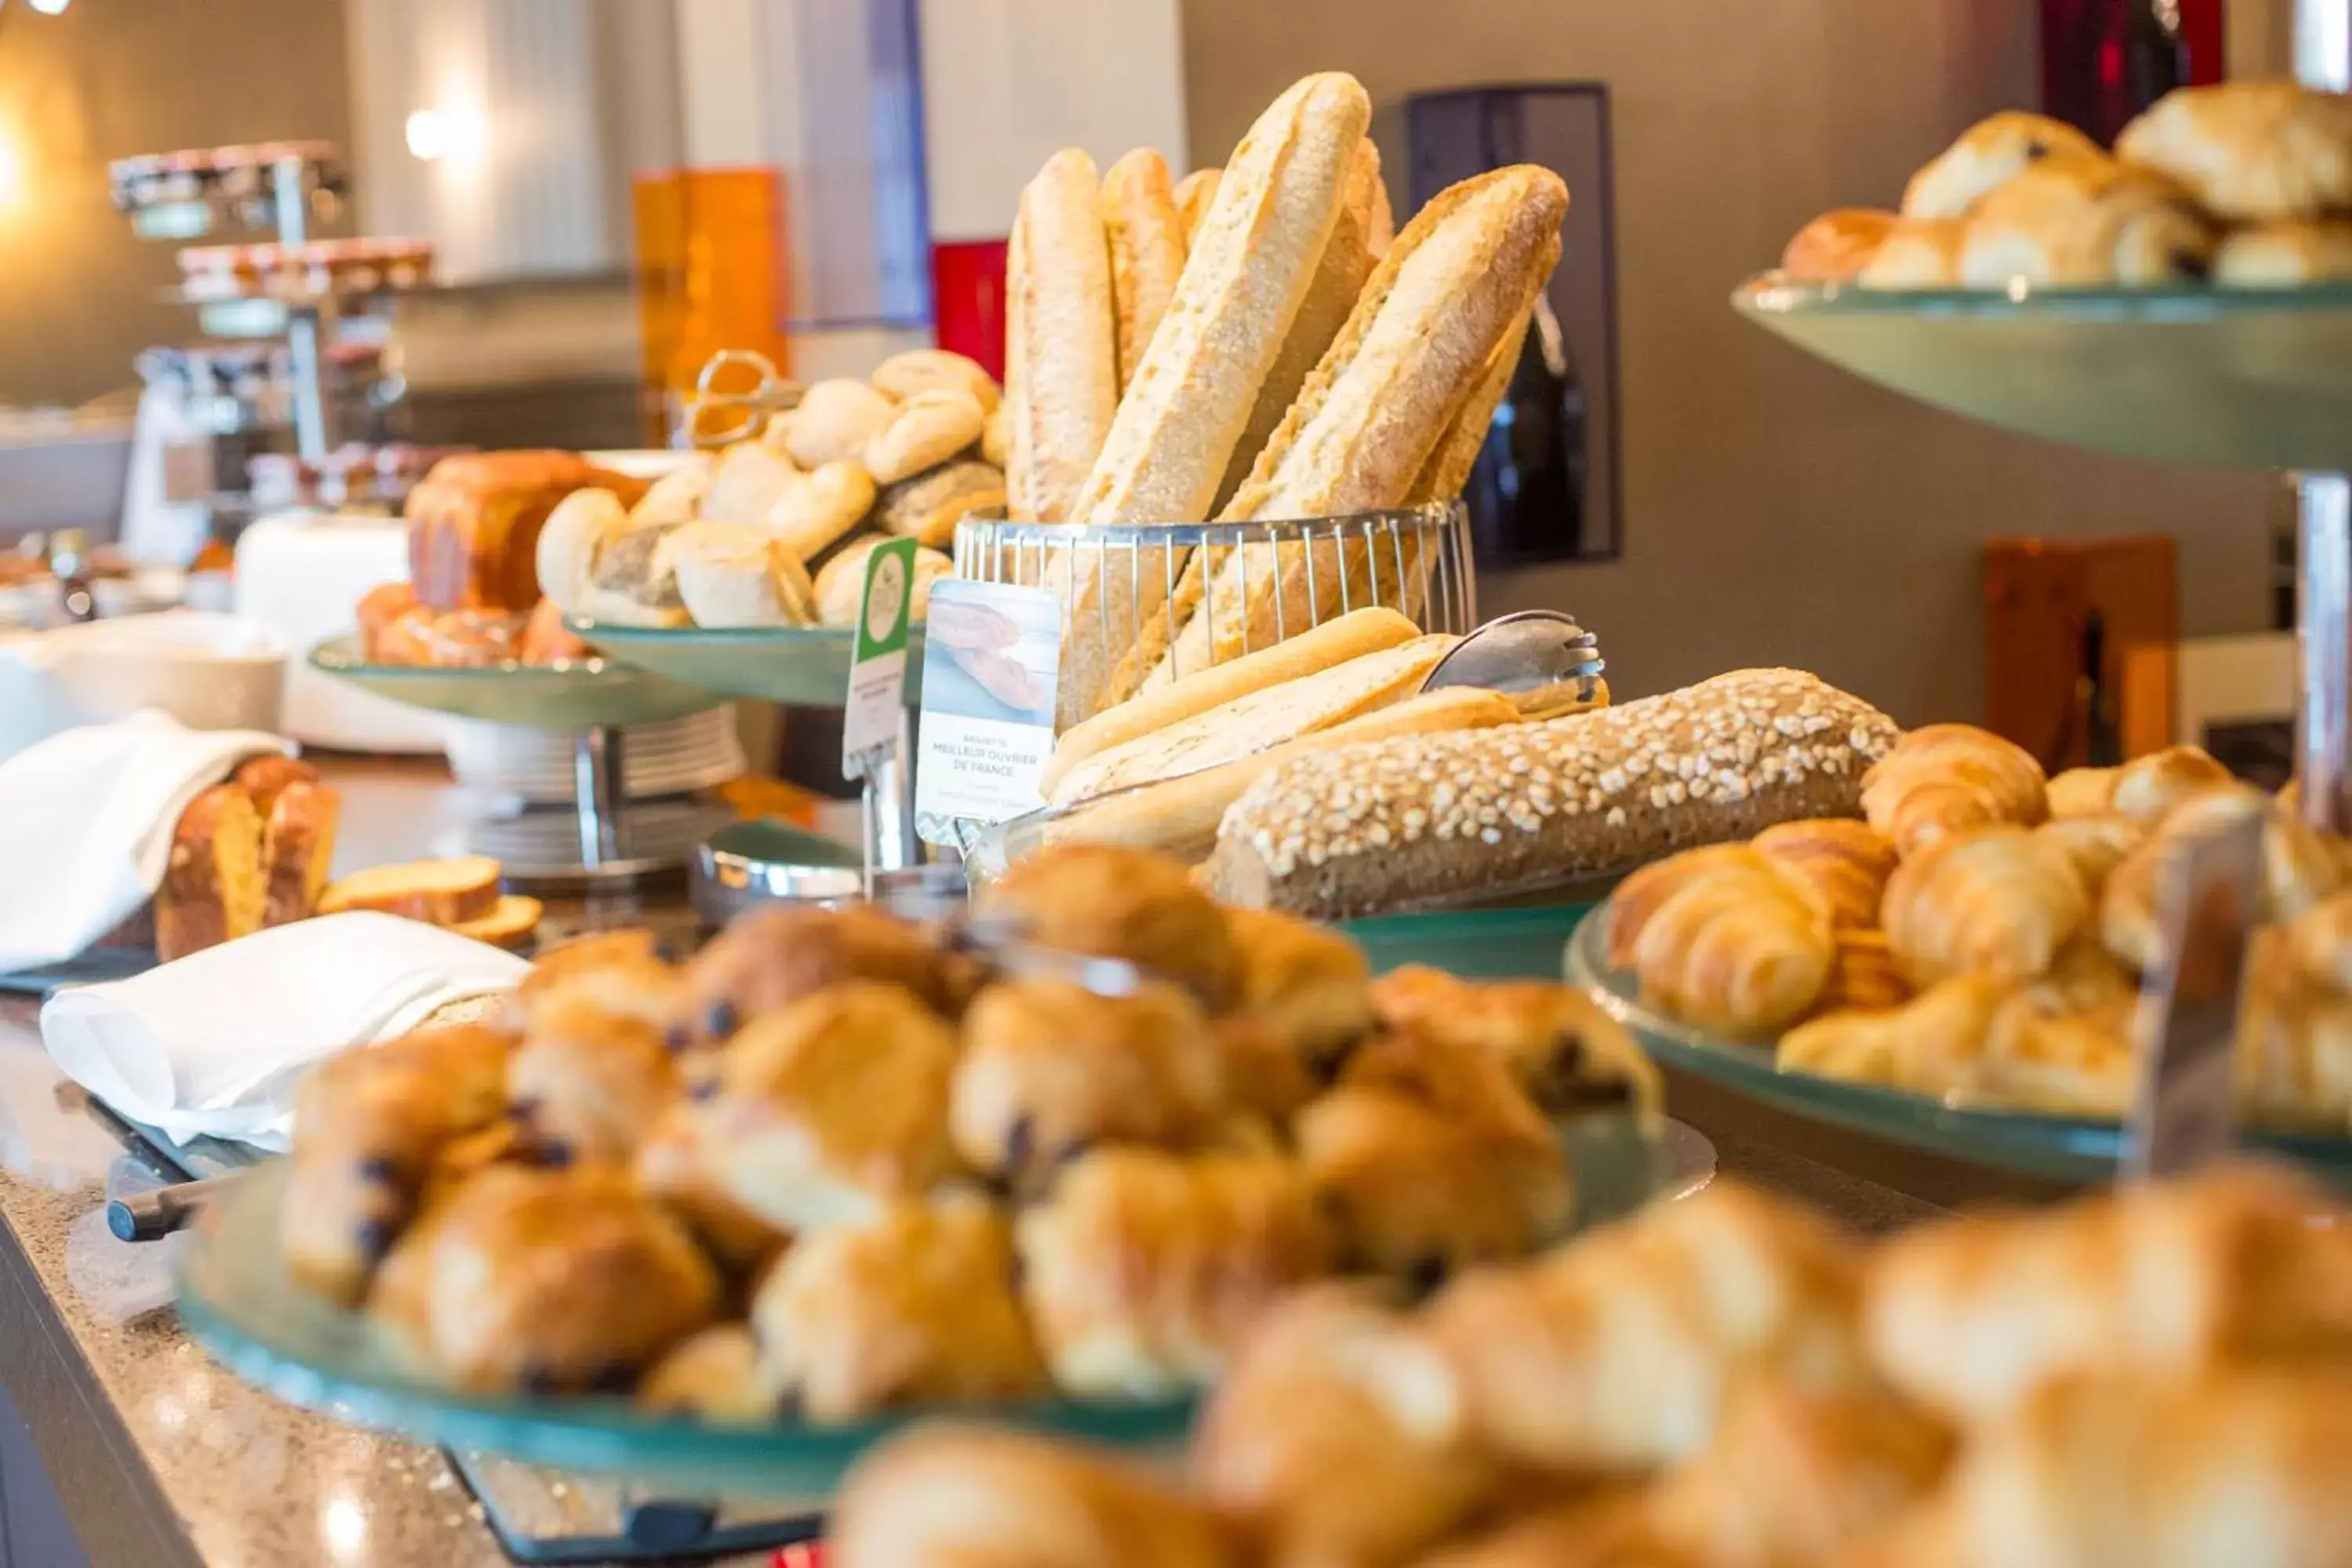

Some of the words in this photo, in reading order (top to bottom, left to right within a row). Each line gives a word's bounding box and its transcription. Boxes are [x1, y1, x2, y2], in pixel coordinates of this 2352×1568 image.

[933, 742, 985, 758] MEILLEUR
[987, 750, 1037, 766] OUVRIER
[953, 758, 967, 771] DE
[971, 762, 1014, 777] FRANCE
